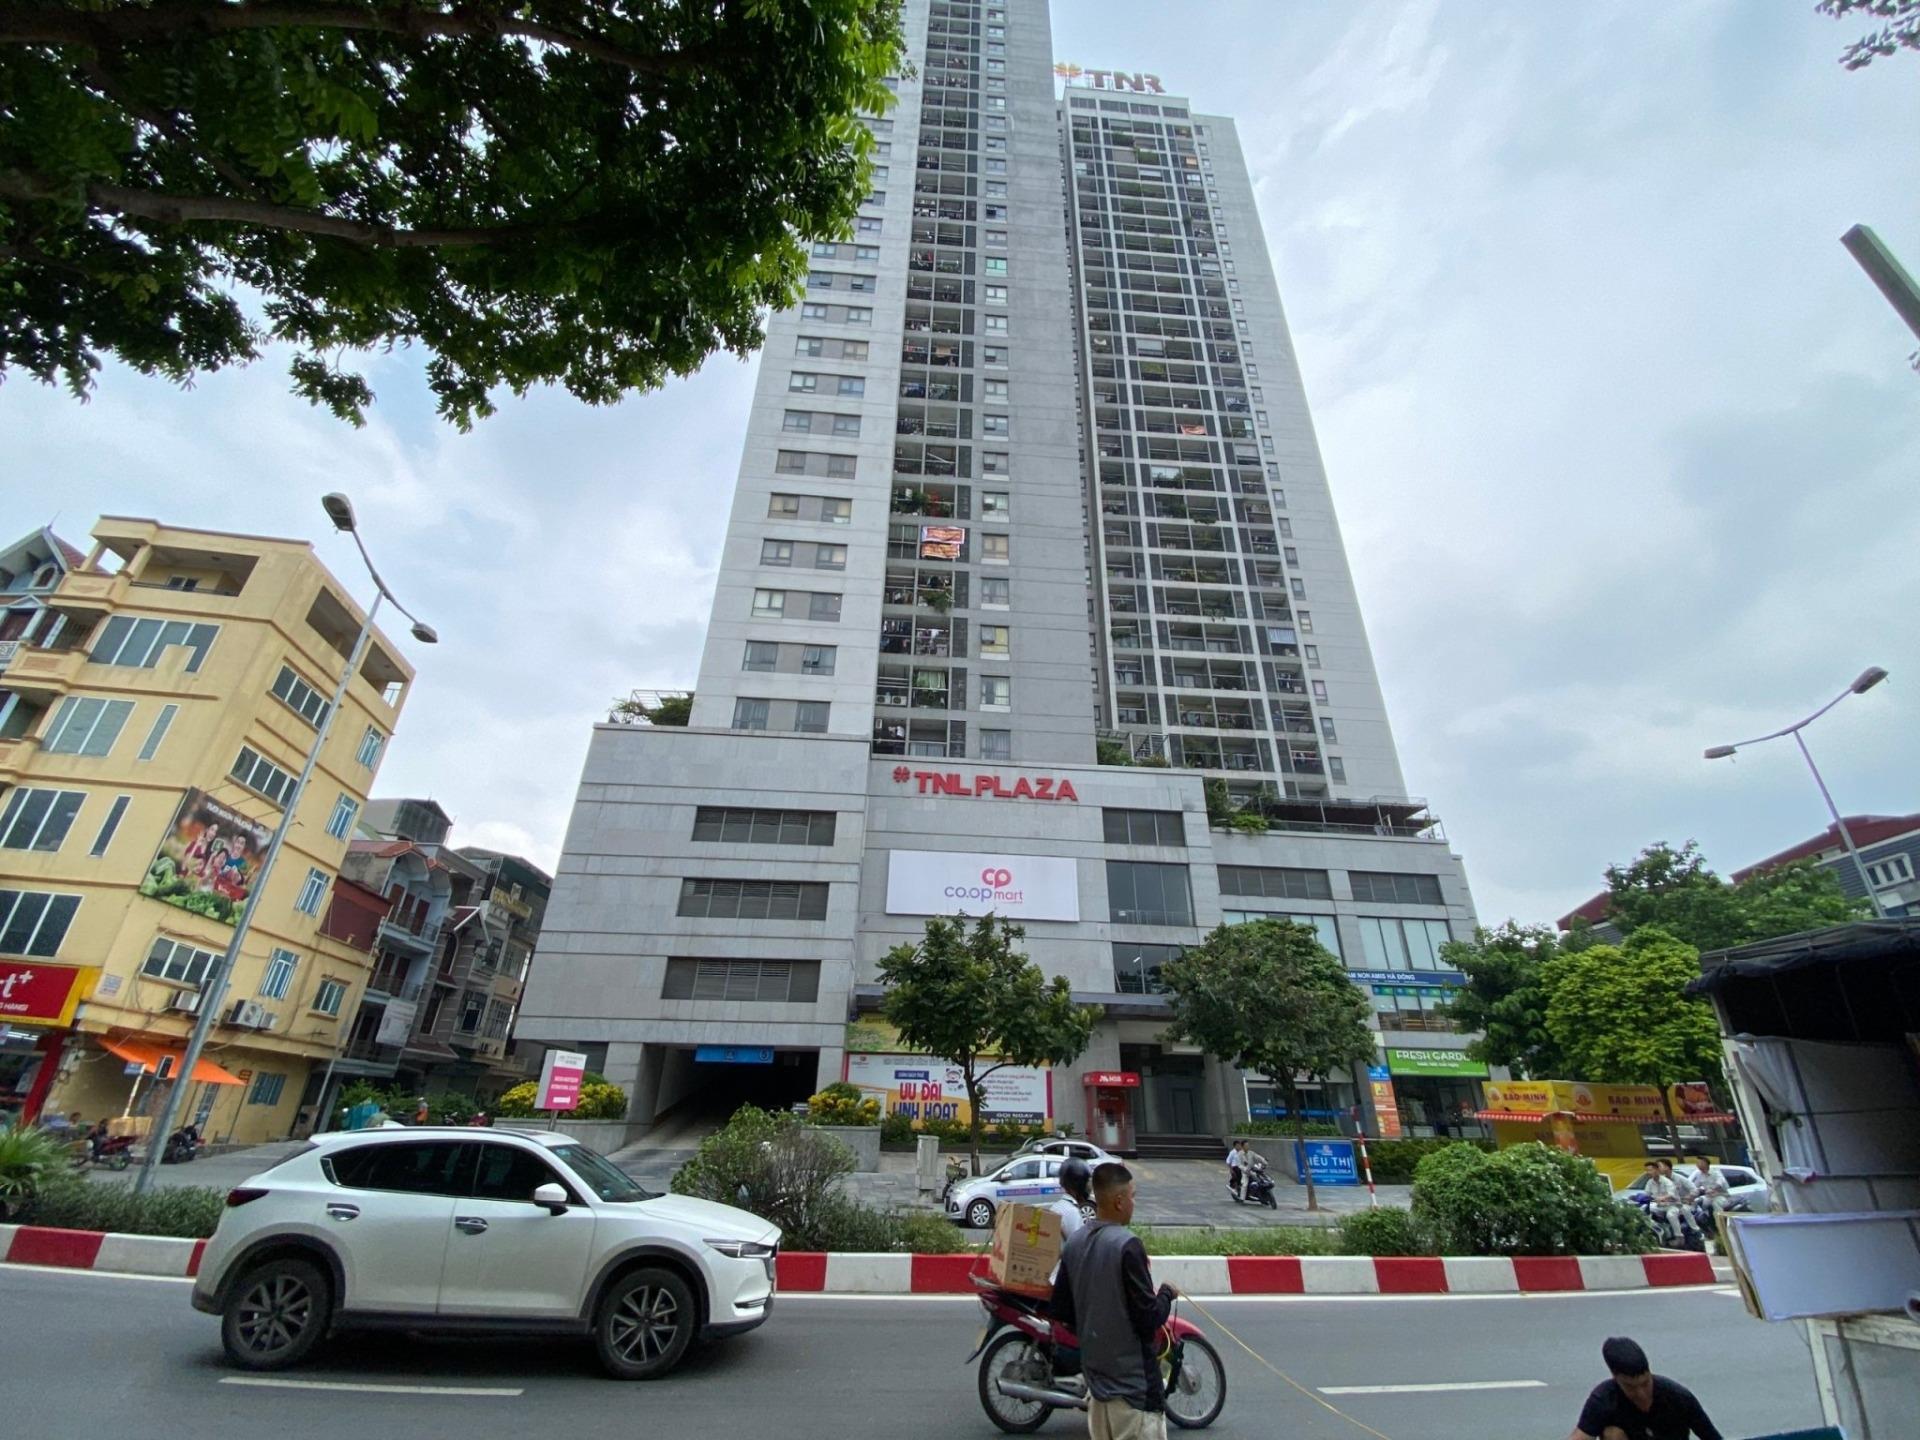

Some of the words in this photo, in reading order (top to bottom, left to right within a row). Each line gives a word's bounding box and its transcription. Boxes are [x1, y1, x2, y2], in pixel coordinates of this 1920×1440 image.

[1085, 69, 1166, 93] TNR
[914, 771, 972, 796] TNL
[975, 775, 1079, 802] PLAZA
[1396, 1050, 1430, 1060] FRESH
[921, 1079, 942, 1102] ĐÃI
[1306, 1154, 1329, 1166] IÊU
